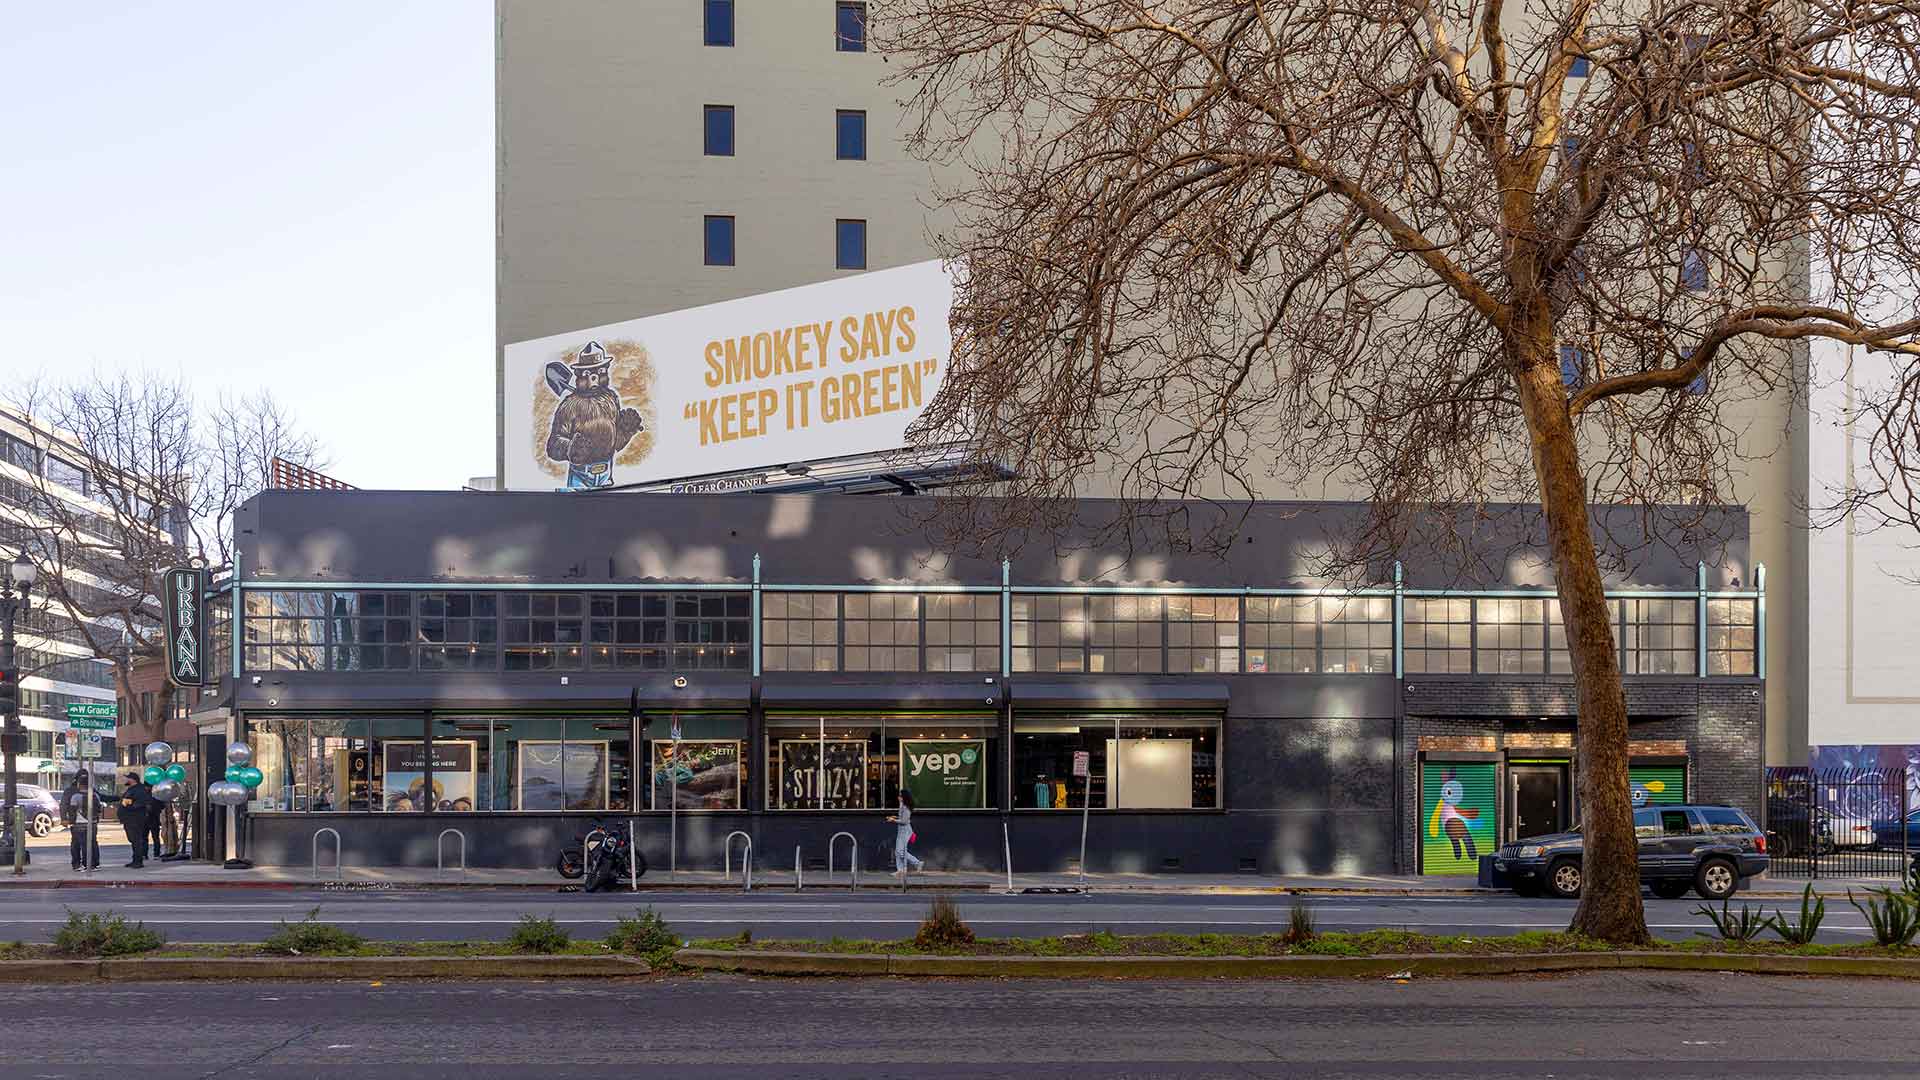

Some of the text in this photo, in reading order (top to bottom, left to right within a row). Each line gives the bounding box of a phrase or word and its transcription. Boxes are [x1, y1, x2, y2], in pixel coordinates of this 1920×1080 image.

[704, 306, 916, 387] SMOKEY SAYS
[786, 381, 815, 431] IT
[176, 574, 198, 677] URBANA
[87, 706, 110, 715] Grand
[712, 747, 735, 756] JETTY
[910, 753, 961, 776] yep
